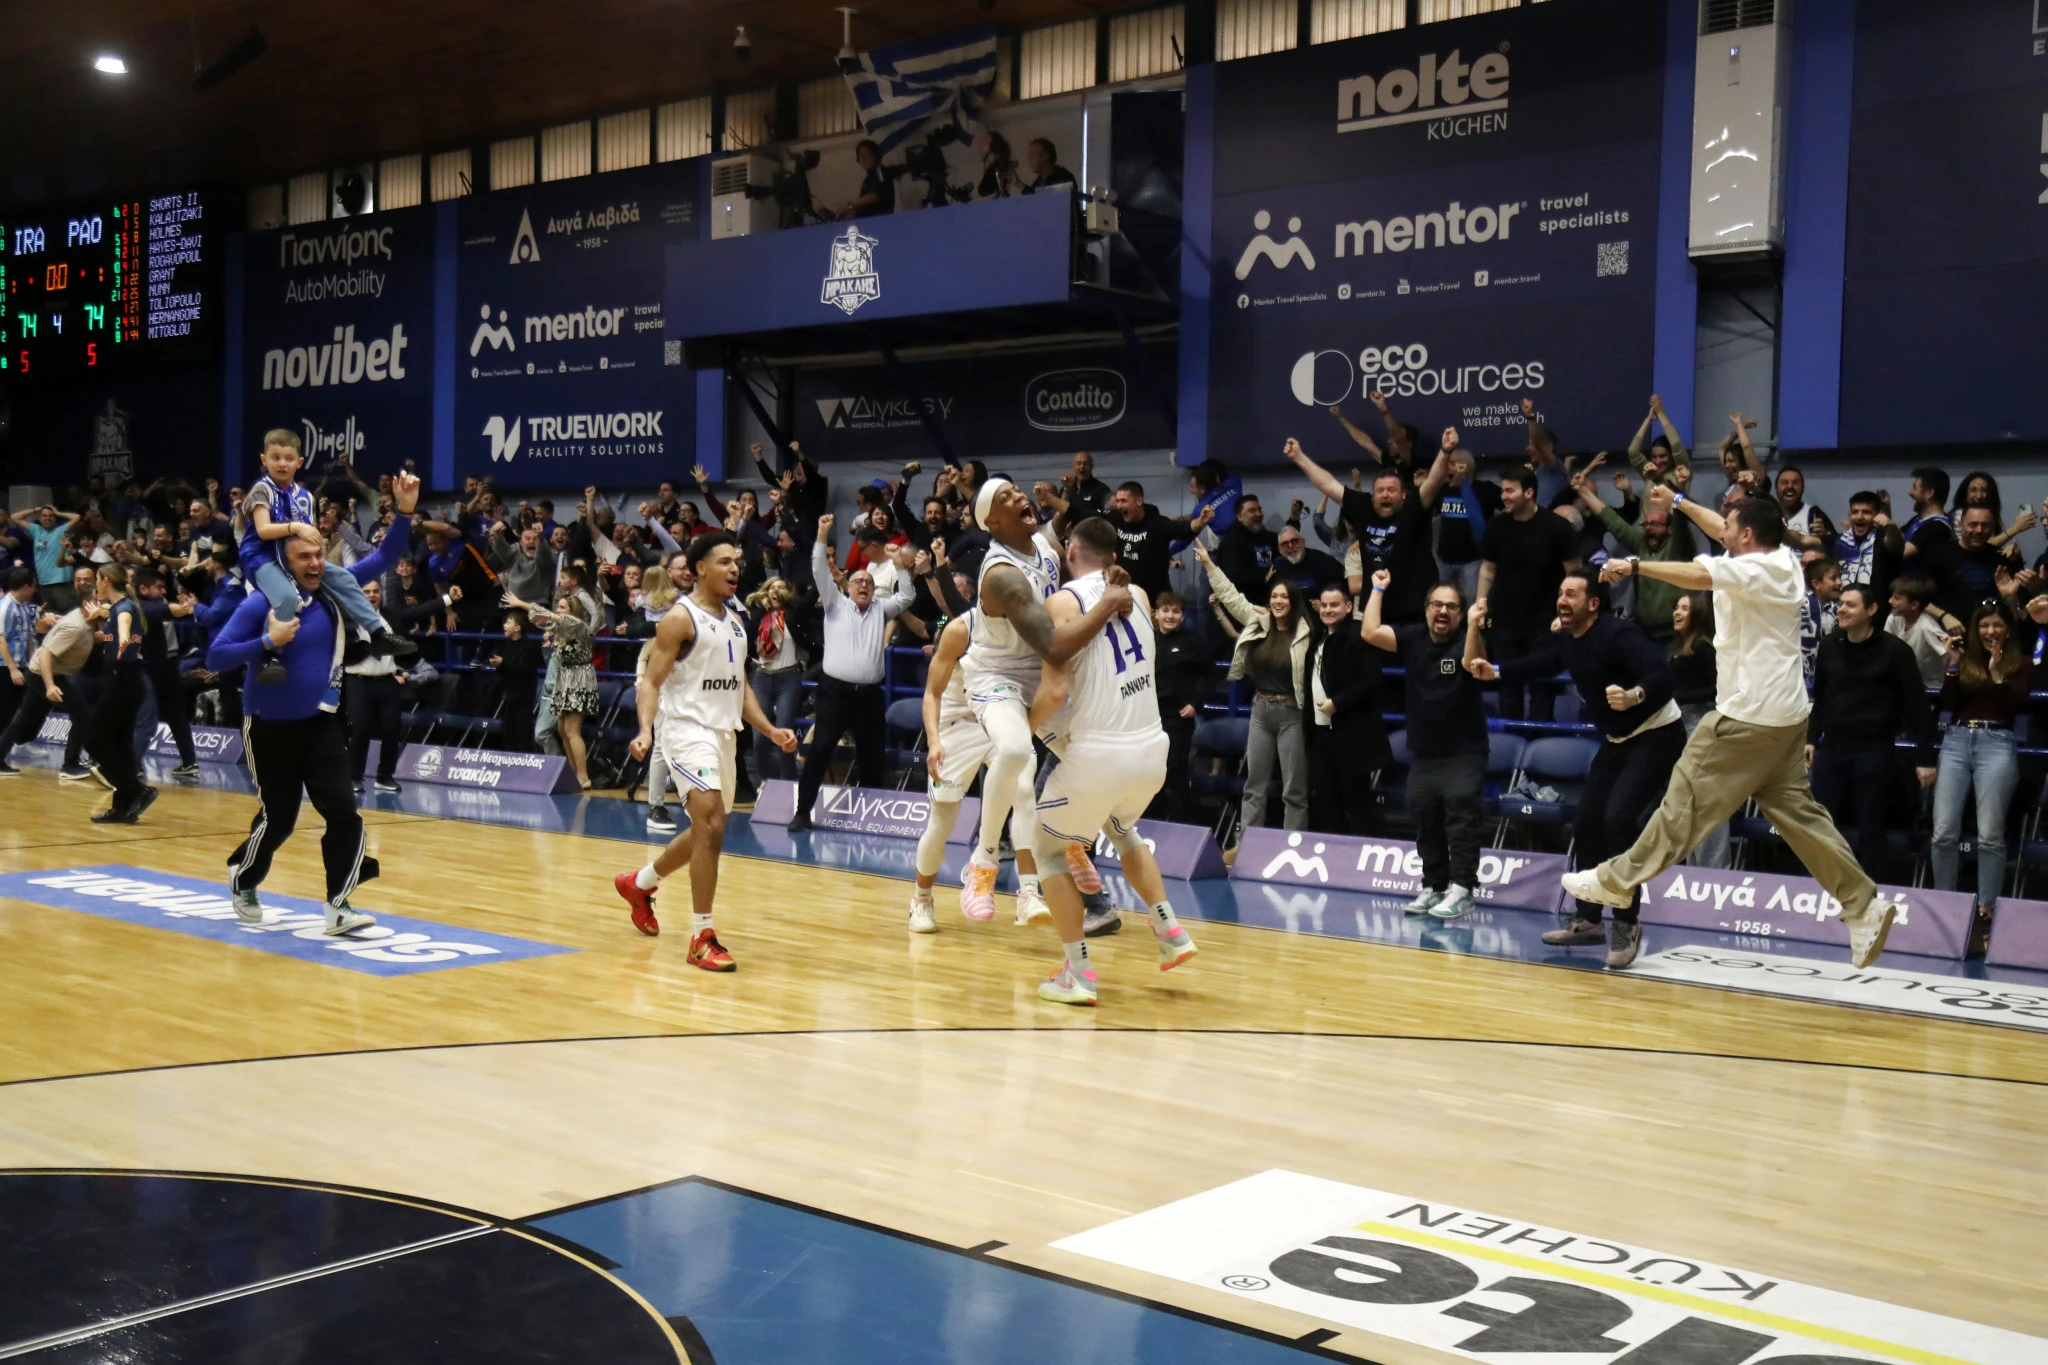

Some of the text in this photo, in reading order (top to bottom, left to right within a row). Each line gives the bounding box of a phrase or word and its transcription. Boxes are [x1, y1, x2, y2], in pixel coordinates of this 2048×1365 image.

[1338, 49, 1510, 120] nolte
[1427, 112, 1509, 140] KÜCHEN
[150, 196, 182, 212] SHORTS
[1540, 193, 1588, 212] travel
[547, 211, 583, 236] Αυγά
[586, 202, 640, 231] Λαβιδά
[1335, 202, 1520, 258] mentor
[1539, 210, 1629, 235] specialists
[14, 216, 102, 256] IRA PAO
[150, 225, 182, 241] HOLMES
[281, 223, 394, 268] Γιαννίρης
[149, 267, 176, 283] GRANT
[285, 269, 386, 303] AutoMobility
[1494, 274, 1541, 286] mentor.travel
[149, 282, 171, 297] NUNN
[1356, 289, 1386, 299] mentor.ts
[1415, 281, 1460, 293] MentorTravel
[634, 304, 661, 316] travel
[1253, 293, 1327, 307] Mentor Travel Specialists
[18, 303, 104, 338] 74 4 74
[149, 323, 191, 339] MITOGLOU
[525, 305, 625, 344] mentor
[20, 342, 97, 373] 5 5
[263, 323, 408, 390] novibet
[1359, 344, 1428, 373] eco
[1362, 362, 1545, 399] resources
[1036, 384, 1114, 414] Condito
[1463, 402, 1519, 417] we make
[528, 411, 664, 442] TRUEWORK
[888, 418, 922, 429] EQUIPME
[1463, 415, 1501, 428] waste
[302, 415, 364, 470] Dimello
[528, 443, 665, 458] FACILITY SOLUTIONS
[727, 639, 735, 663] 1
[1104, 615, 1147, 676] 14
[454, 750, 546, 770] Αβγά Νεοχωρούδας
[448, 766, 502, 787] τσακίρη
[1376, 795, 1385, 804] 41
[1521, 805, 1533, 815] 43
[822, 818, 925, 837] MEDICAL EQUIPMENT
[1357, 843, 1523, 885] meor
[1372, 877, 1413, 892] travel
[1664, 874, 1755, 910] Αυγά
[1734, 920, 1772, 936] 1958
[1386, 1203, 1779, 1302] KÜCHEN
